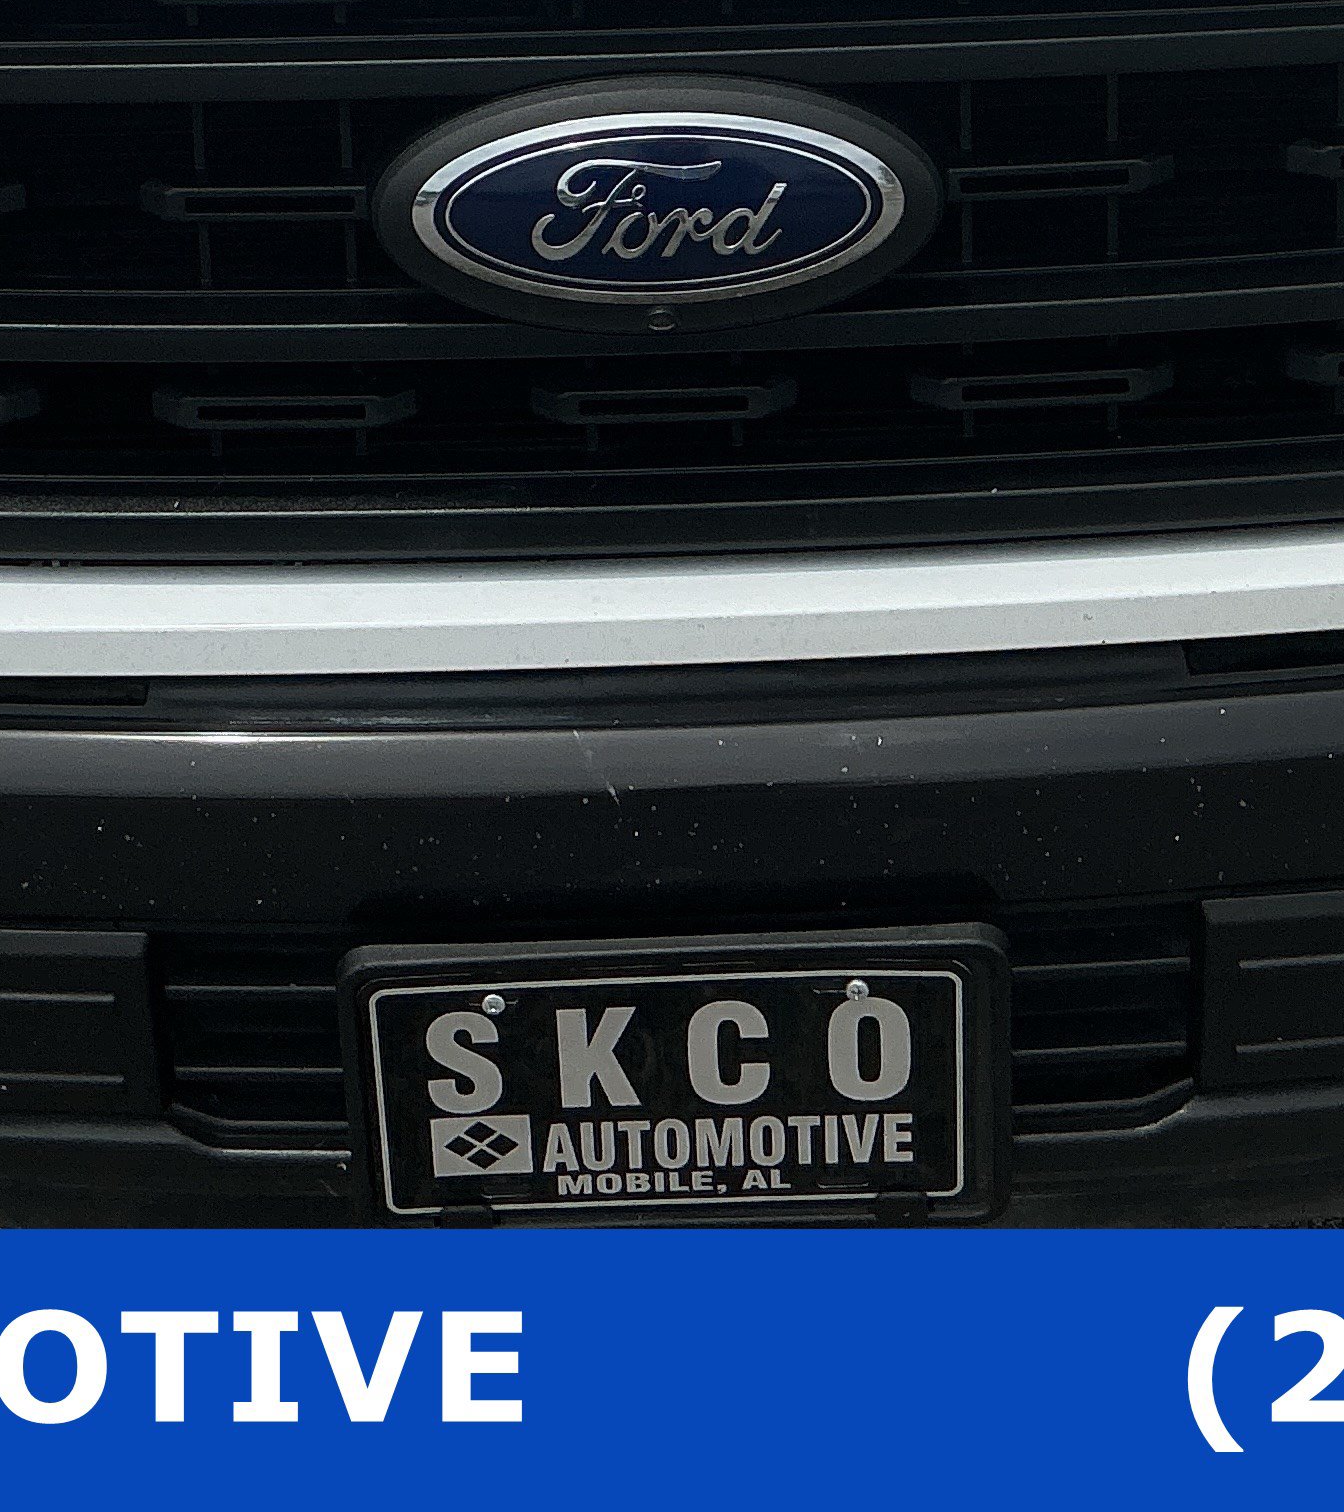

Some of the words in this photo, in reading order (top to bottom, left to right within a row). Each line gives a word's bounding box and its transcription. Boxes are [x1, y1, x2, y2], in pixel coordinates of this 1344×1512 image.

[532, 158, 788, 260] Ford
[543, 1113, 914, 1173] AUTOMOTIVE
[557, 1169, 728, 1195] MOBILE,
[741, 1168, 791, 1190] AL
